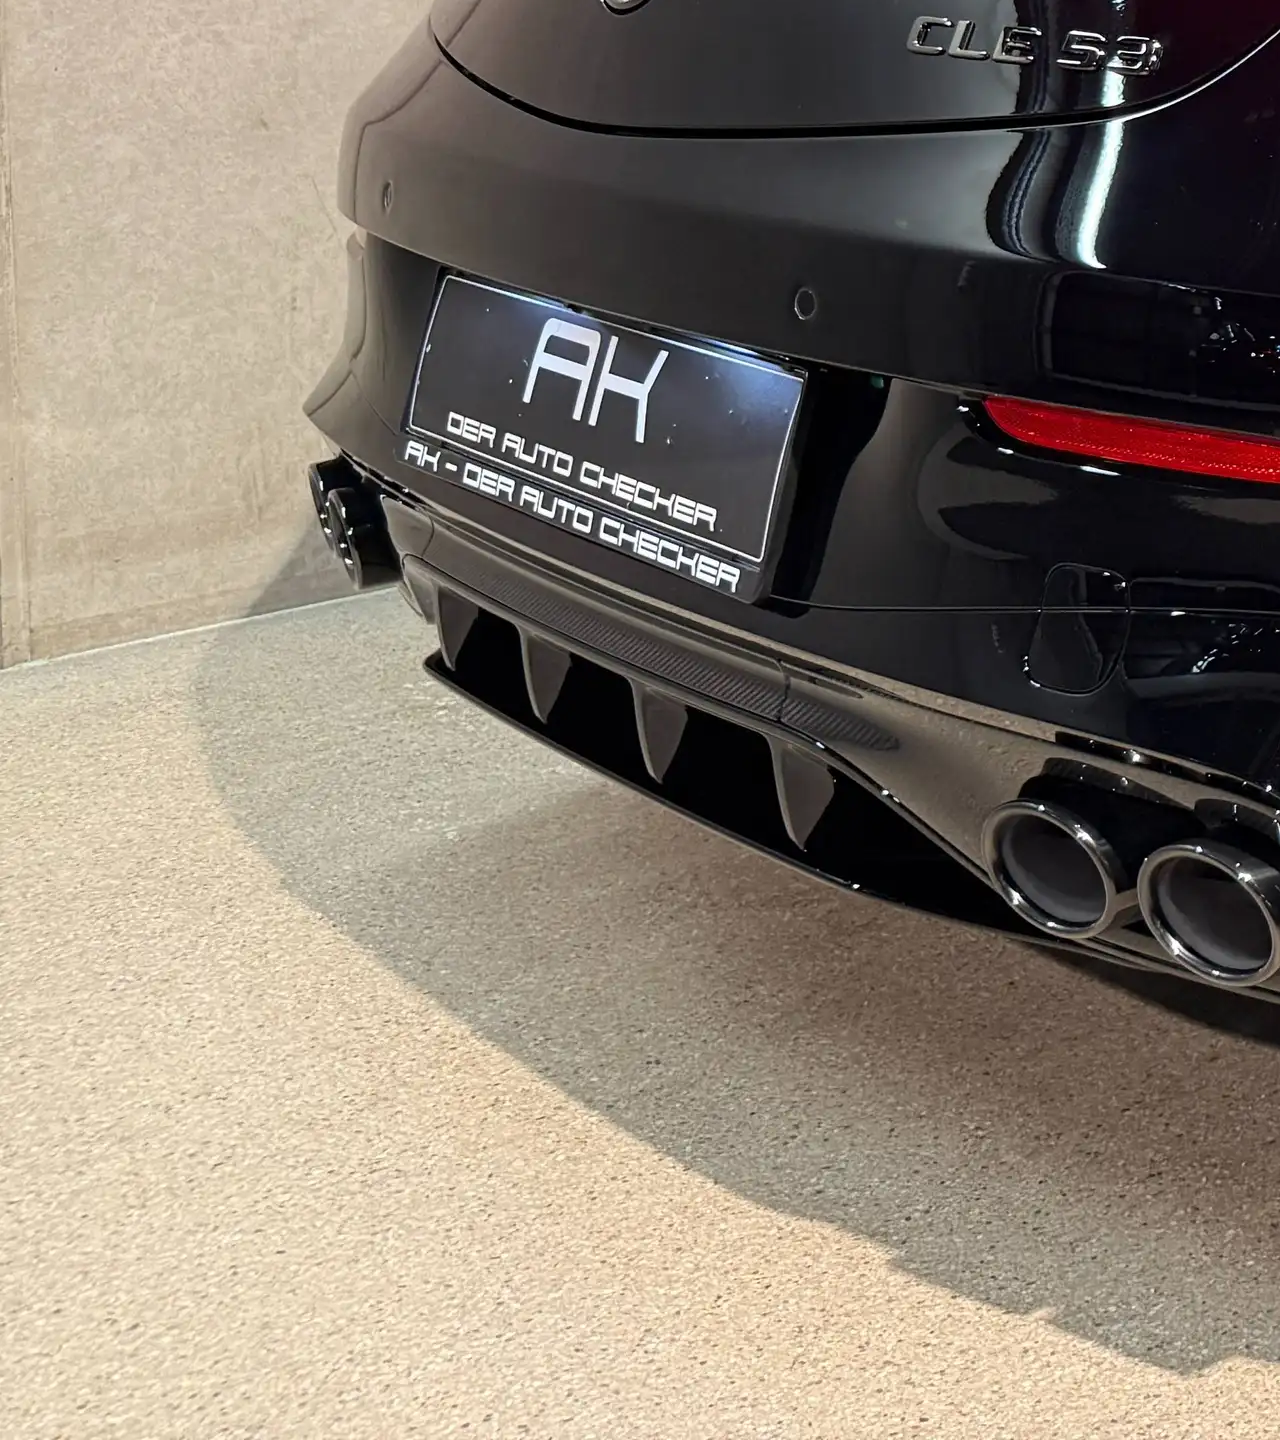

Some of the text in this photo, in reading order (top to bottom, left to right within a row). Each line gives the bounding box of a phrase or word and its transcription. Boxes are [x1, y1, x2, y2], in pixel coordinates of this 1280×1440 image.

[906, 15, 1163, 76] CLE 53
[521, 317, 670, 444] AK
[404, 440, 441, 473] AK
[462, 462, 516, 502] DER
[519, 485, 594, 534] AUTO
[599, 517, 741, 593] CHECKER
[446, 411, 718, 532] DER AUTO CHECKER
